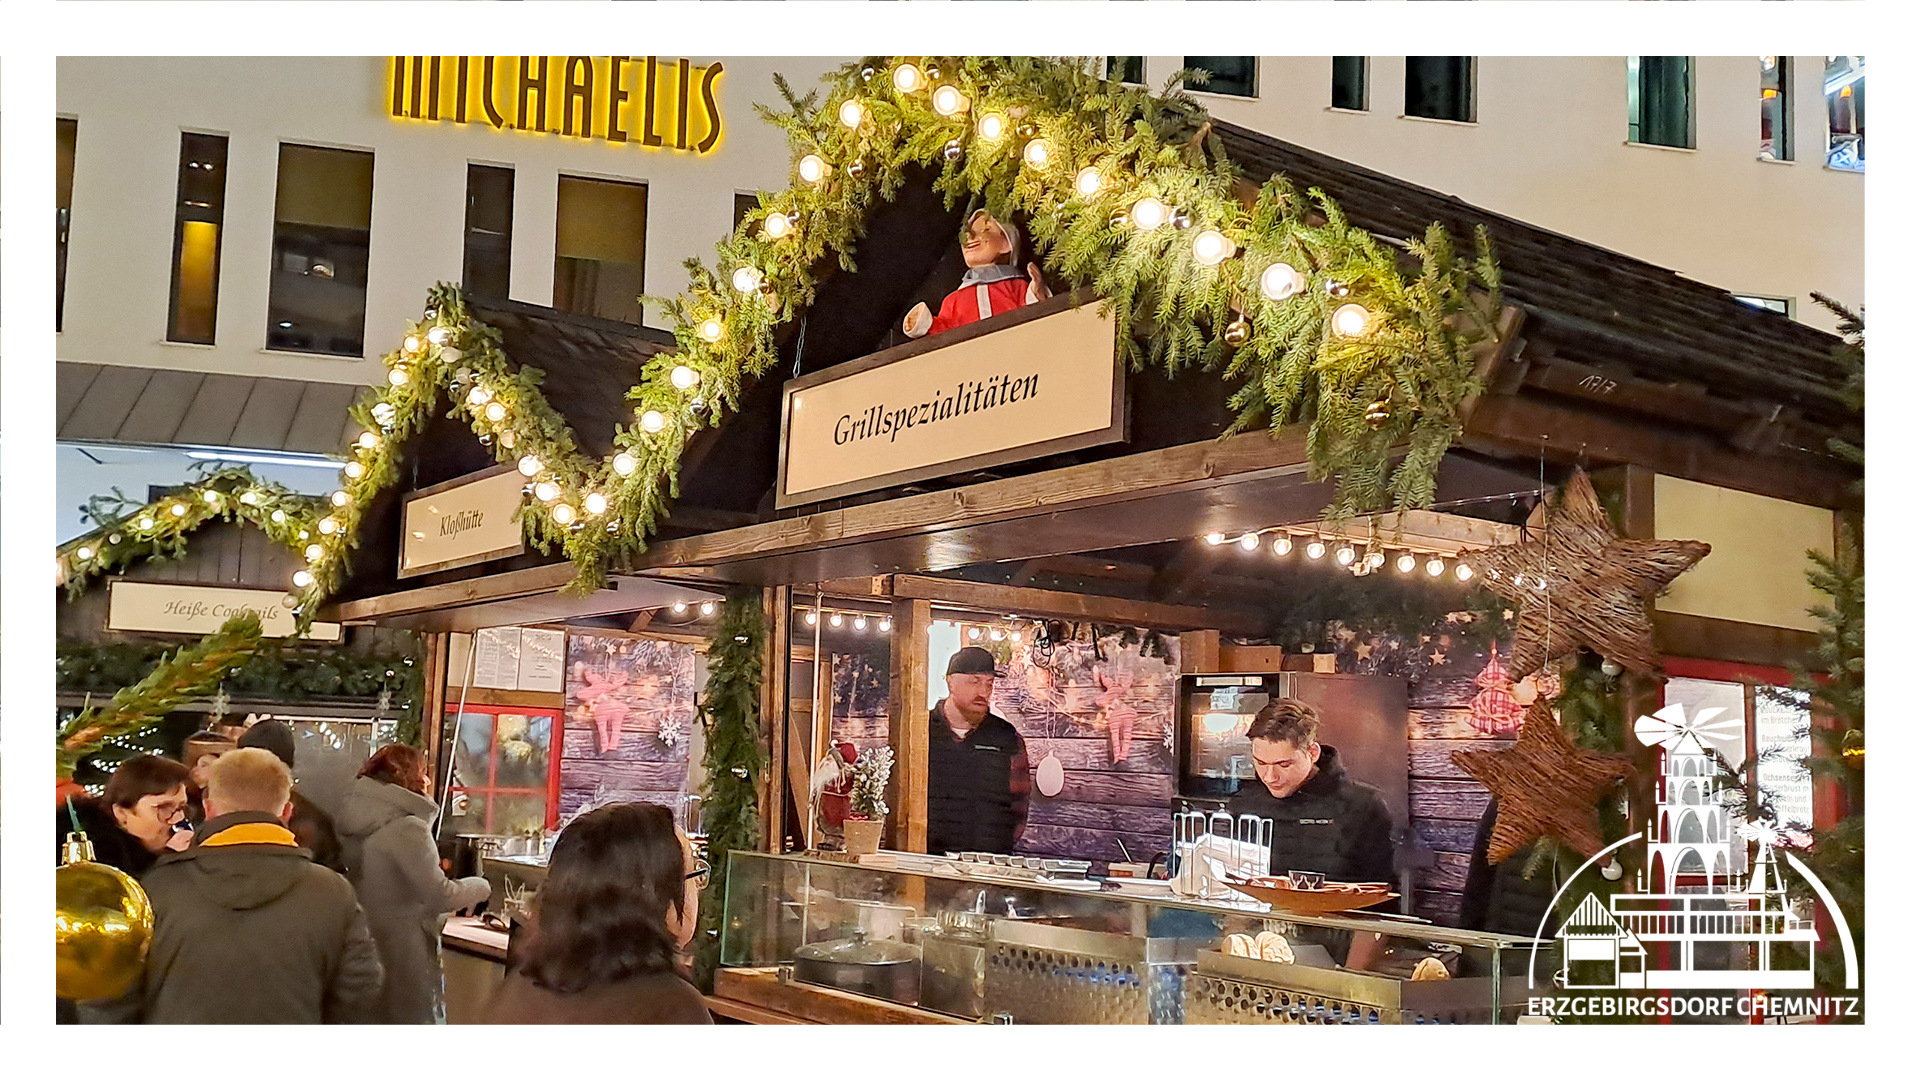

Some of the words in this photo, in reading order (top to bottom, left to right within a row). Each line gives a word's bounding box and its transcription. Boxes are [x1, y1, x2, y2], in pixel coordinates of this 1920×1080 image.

[393, 56, 723, 153] MICHAELIS
[1579, 375, 1617, 394] 17/7
[834, 373, 1039, 446] Grillspezialitäten
[439, 509, 484, 540] Kloßhütte
[164, 600, 208, 621] Heiße
